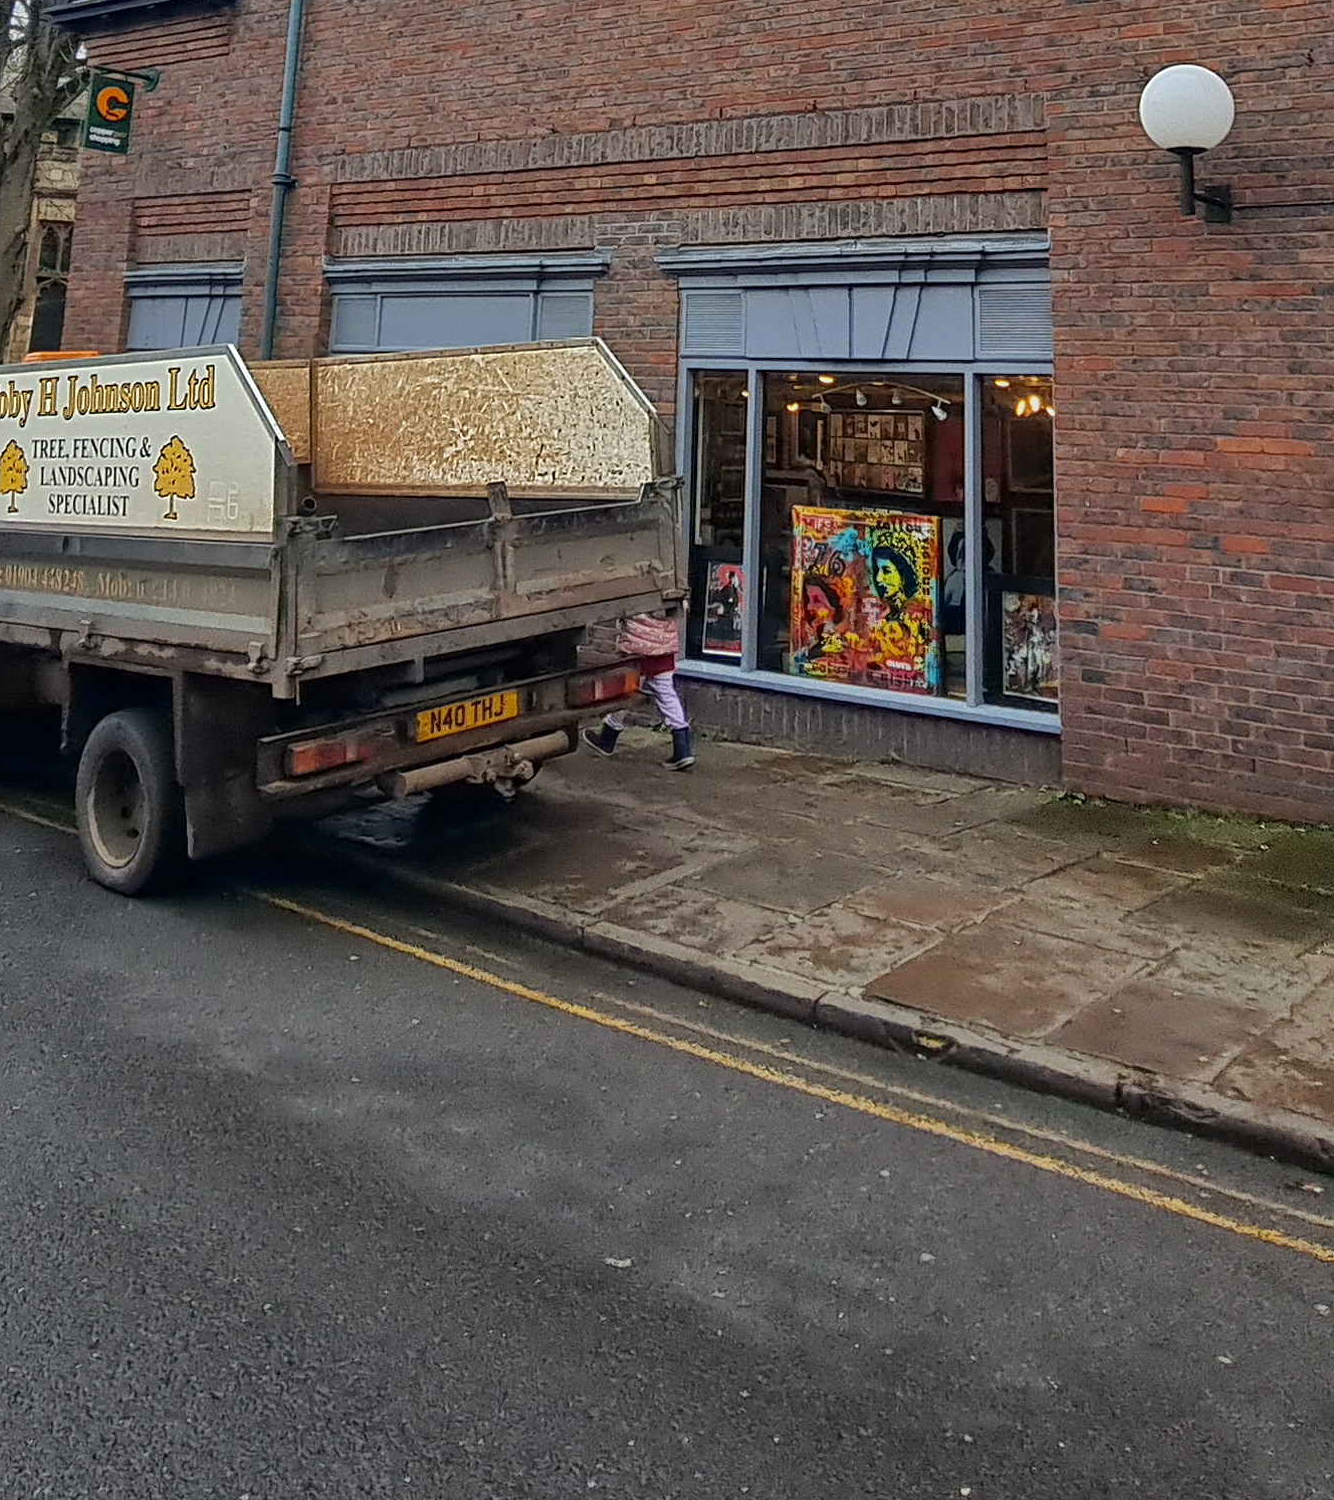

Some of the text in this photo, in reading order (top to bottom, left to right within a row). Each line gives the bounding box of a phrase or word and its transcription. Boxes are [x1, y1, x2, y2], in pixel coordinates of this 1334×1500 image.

[38, 377, 59, 416] H
[63, 374, 161, 420] Johnson
[167, 365, 216, 410] Ltd
[31, 436, 153, 461] TREE, FENCING &
[40, 466, 140, 487] LANDSCAPING
[48, 493, 129, 517] SPECIALIST
[430, 694, 505, 734] N40 THJ
